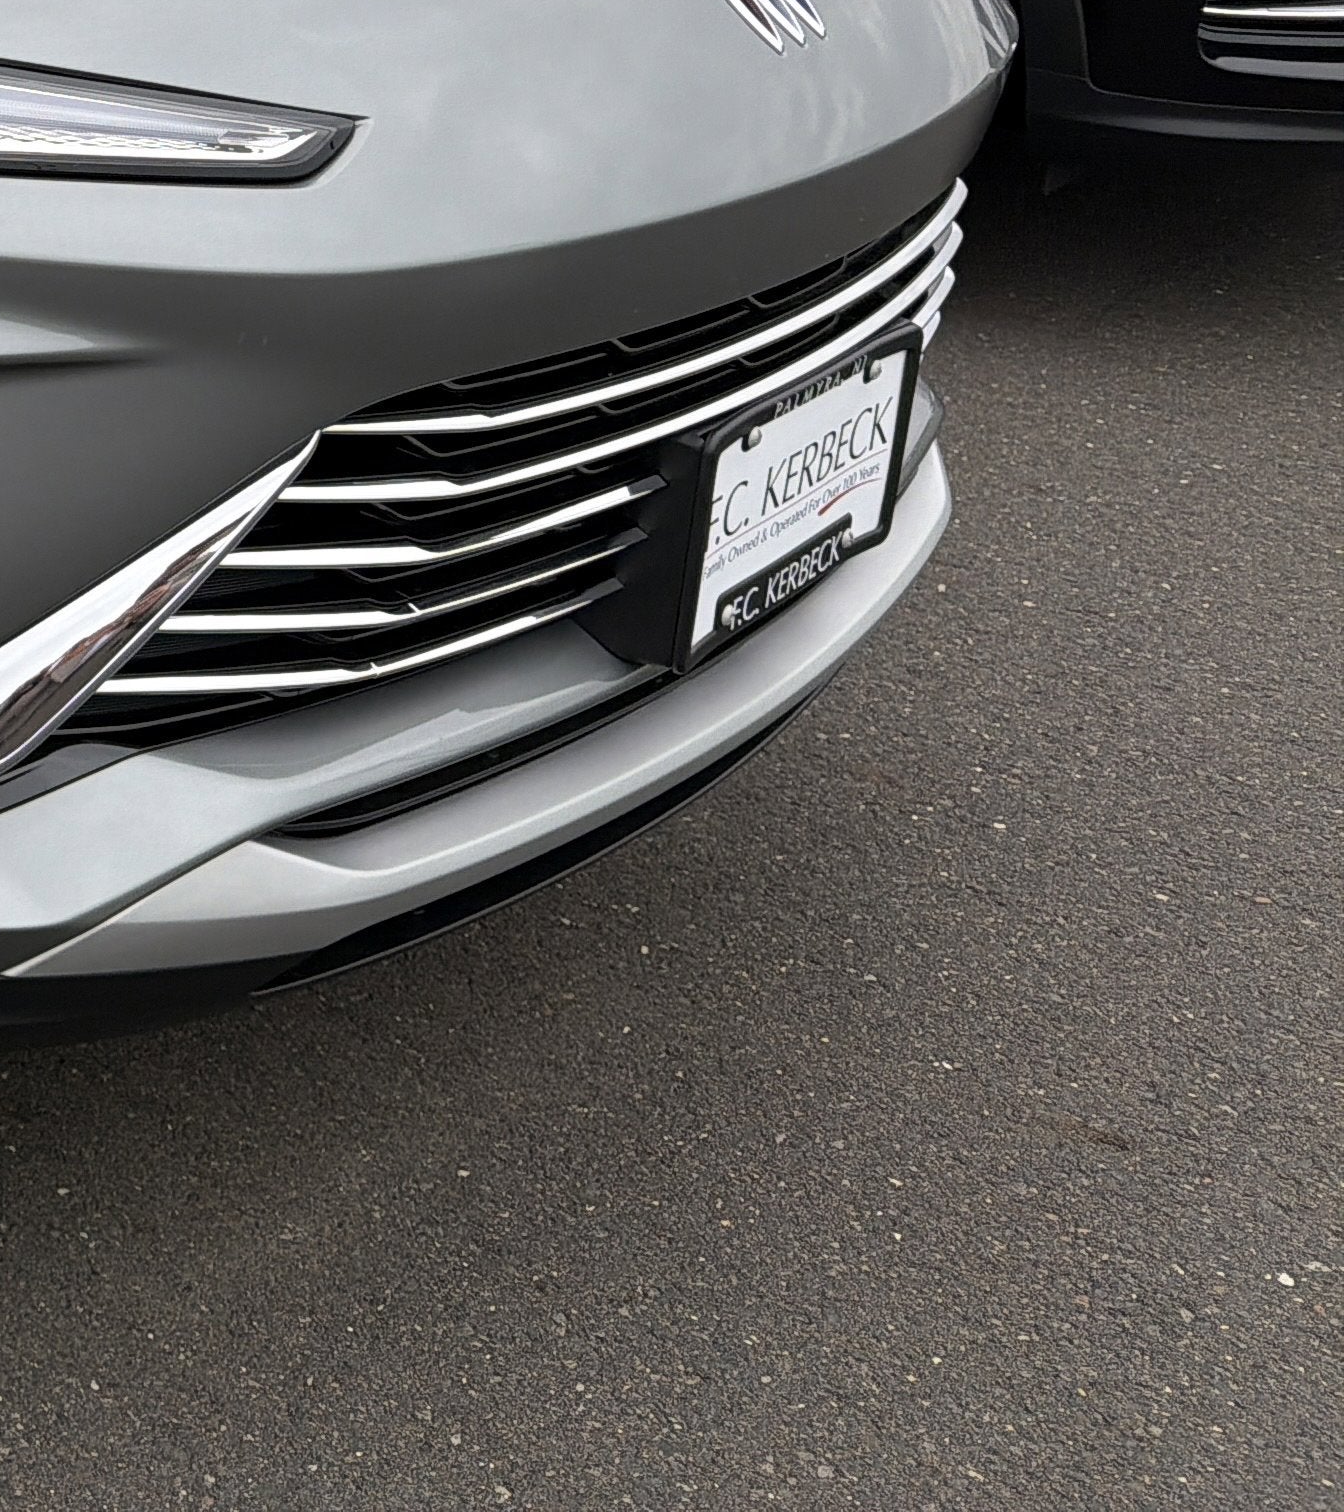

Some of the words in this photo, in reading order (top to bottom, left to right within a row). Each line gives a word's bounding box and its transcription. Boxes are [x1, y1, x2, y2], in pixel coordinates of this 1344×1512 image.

[761, 396, 893, 517] KERBECK
[727, 530, 761, 563] Owned
[770, 501, 809, 538] Operated
[807, 496, 821, 514] For
[822, 484, 841, 504] Over
[842, 472, 858, 490] 100
[859, 463, 881, 481] Years
[730, 586, 760, 631] F.C.
[765, 530, 843, 609] KERBECK
